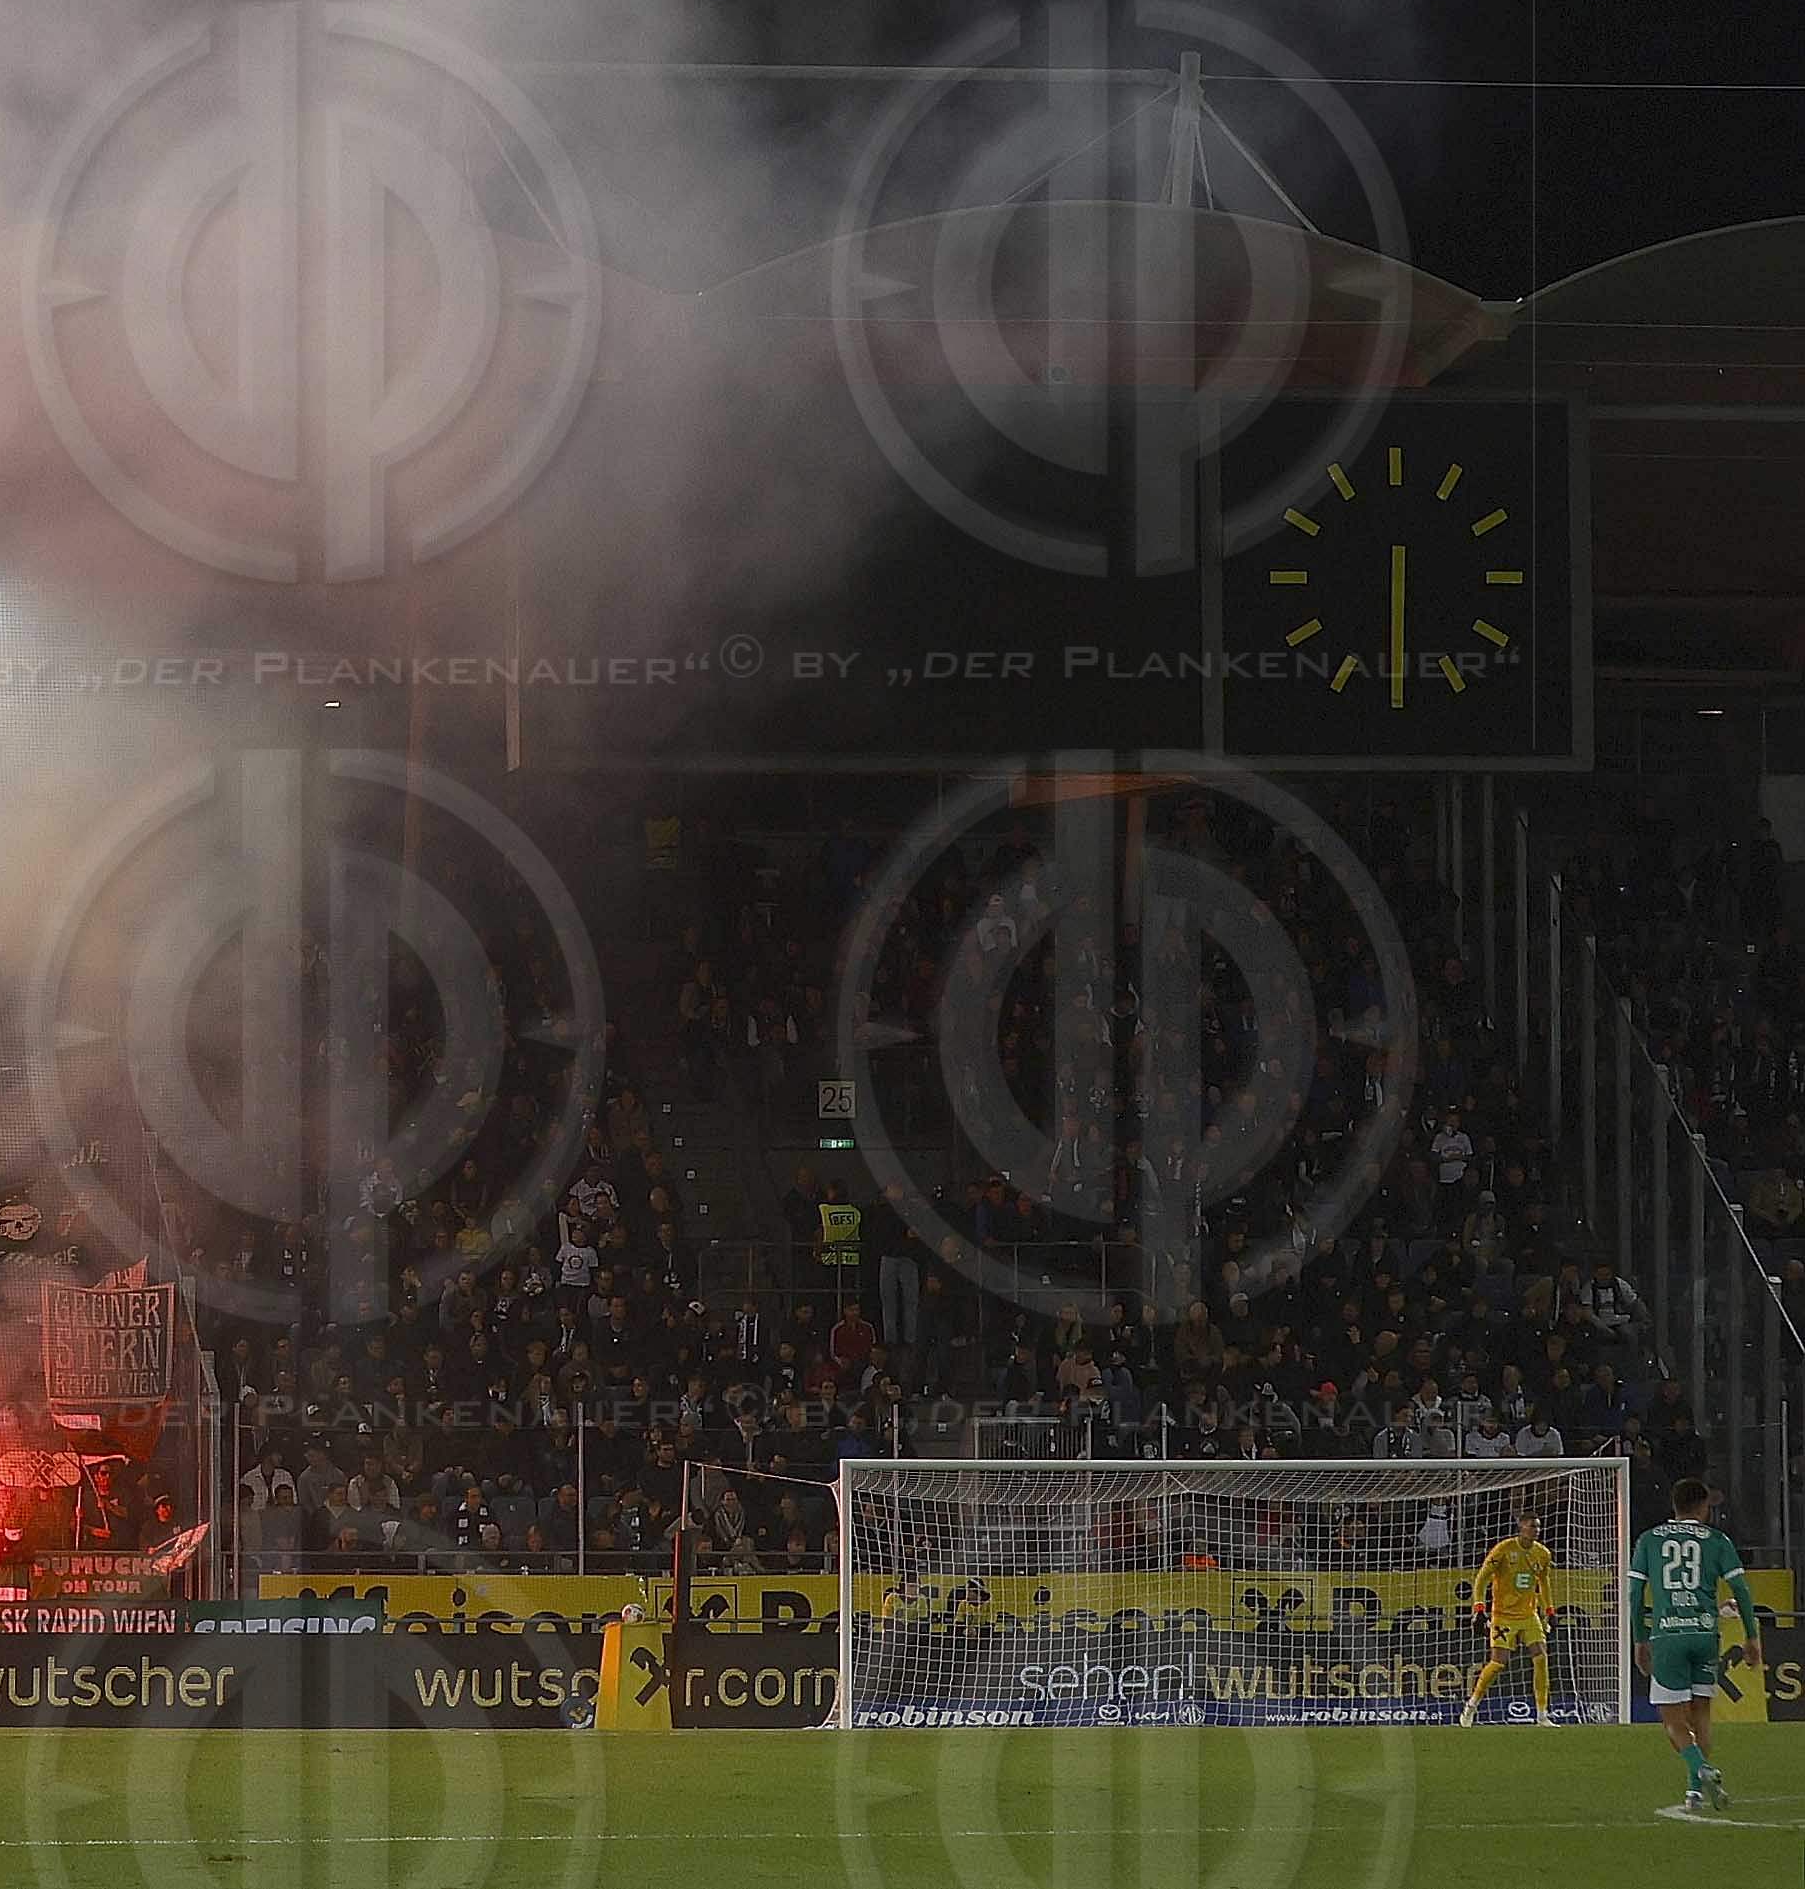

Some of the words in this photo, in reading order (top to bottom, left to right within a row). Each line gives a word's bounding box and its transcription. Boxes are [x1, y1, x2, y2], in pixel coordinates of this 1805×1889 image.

[822, 1087, 852, 1113] 25
[56, 1328, 161, 1370] STERN
[56, 1372, 109, 1394] RAPID
[118, 1372, 160, 1394] WIEN
[1661, 1539, 1702, 1591] 23
[62, 1580, 88, 1594] ON
[92, 1580, 142, 1594] TOUR
[1, 1608, 30, 1634] SK
[37, 1608, 106, 1634] RAPID
[112, 1609, 177, 1634] WIEN
[1659, 1617, 1700, 1630] Allianz
[1019, 1651, 1194, 1702] sehen!
[857, 1706, 1035, 1727] robinson
[1266, 1704, 1444, 1724] www.robinson.at
